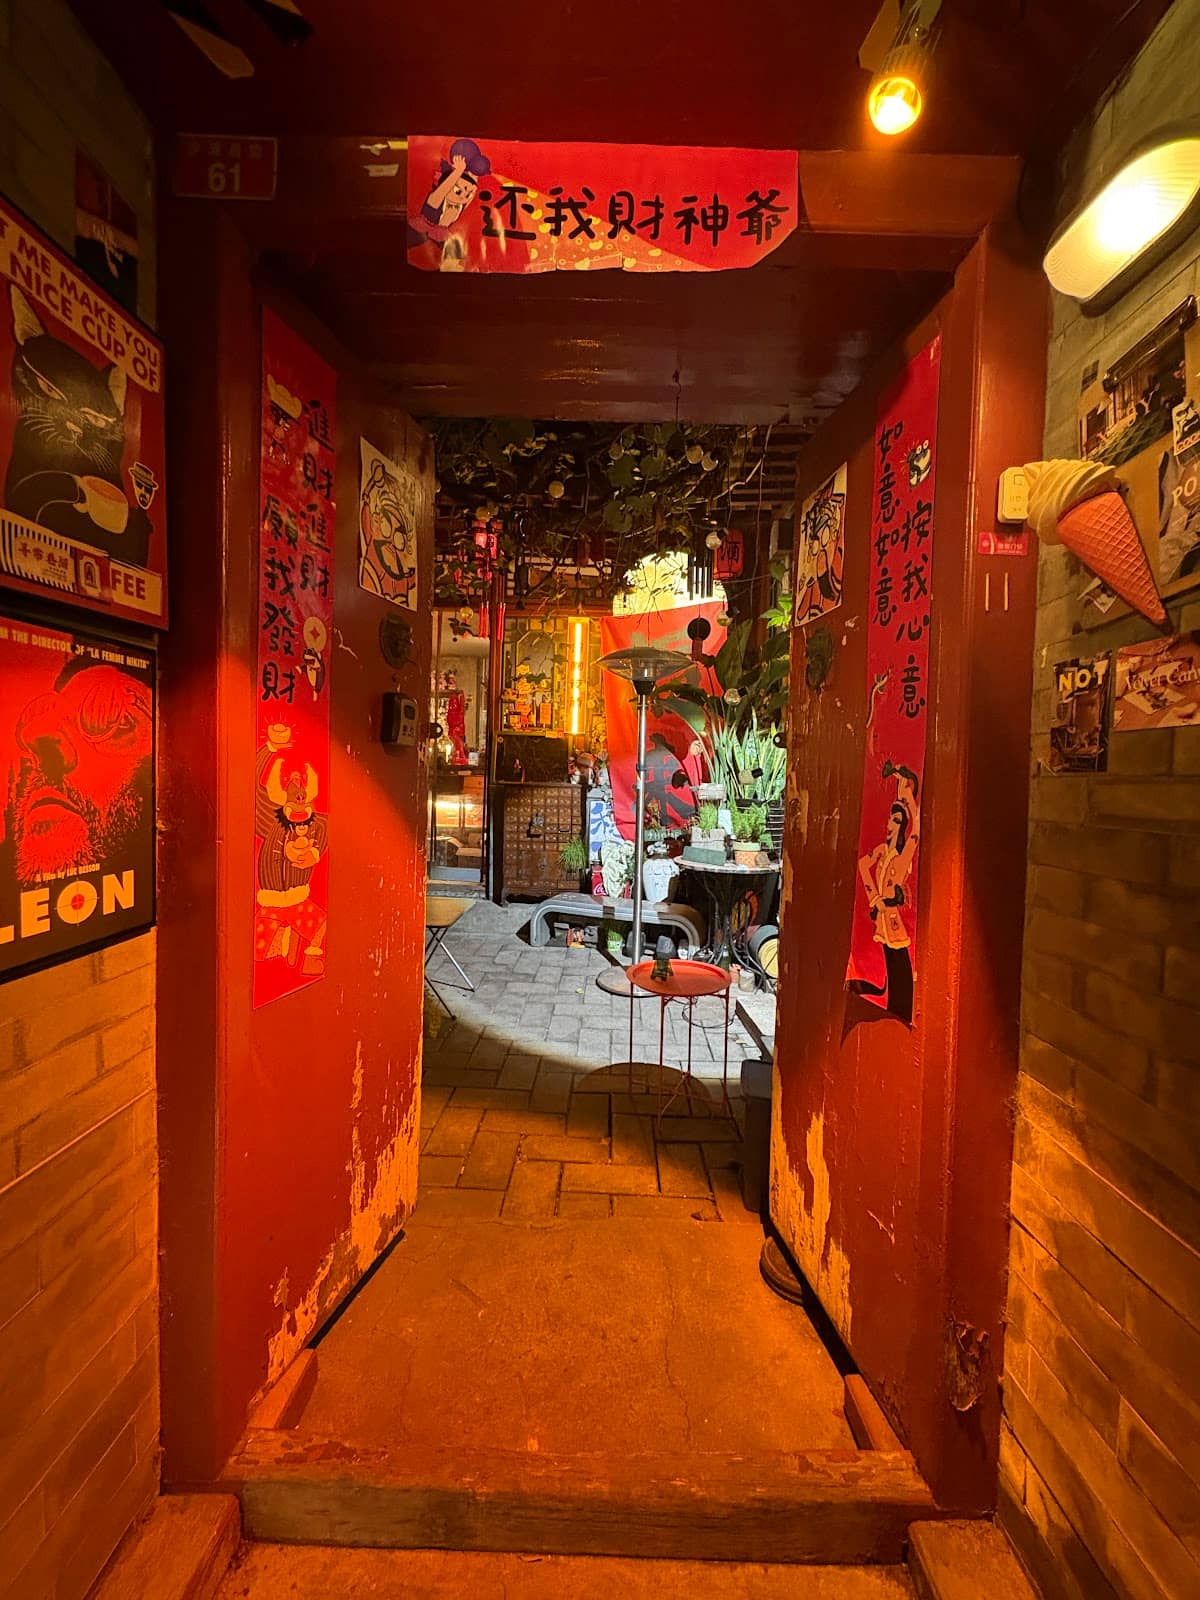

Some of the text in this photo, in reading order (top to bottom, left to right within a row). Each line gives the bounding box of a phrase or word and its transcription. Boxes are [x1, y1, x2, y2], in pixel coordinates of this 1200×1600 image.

[208, 161, 240, 193] 61
[478, 185, 790, 247] 还我財神爺
[10, 252, 157, 387] NICE CUP OF
[18, 236, 52, 279] ME
[59, 270, 116, 333] MAKE
[122, 325, 158, 367] YOU
[872, 420, 903, 627] 如意如意
[111, 569, 147, 601] FEE
[896, 499, 933, 718] 按我心意
[12, 629, 29, 645] THE
[31, 634, 73, 654] DIRECTOR
[1058, 667, 1106, 692] NOT
